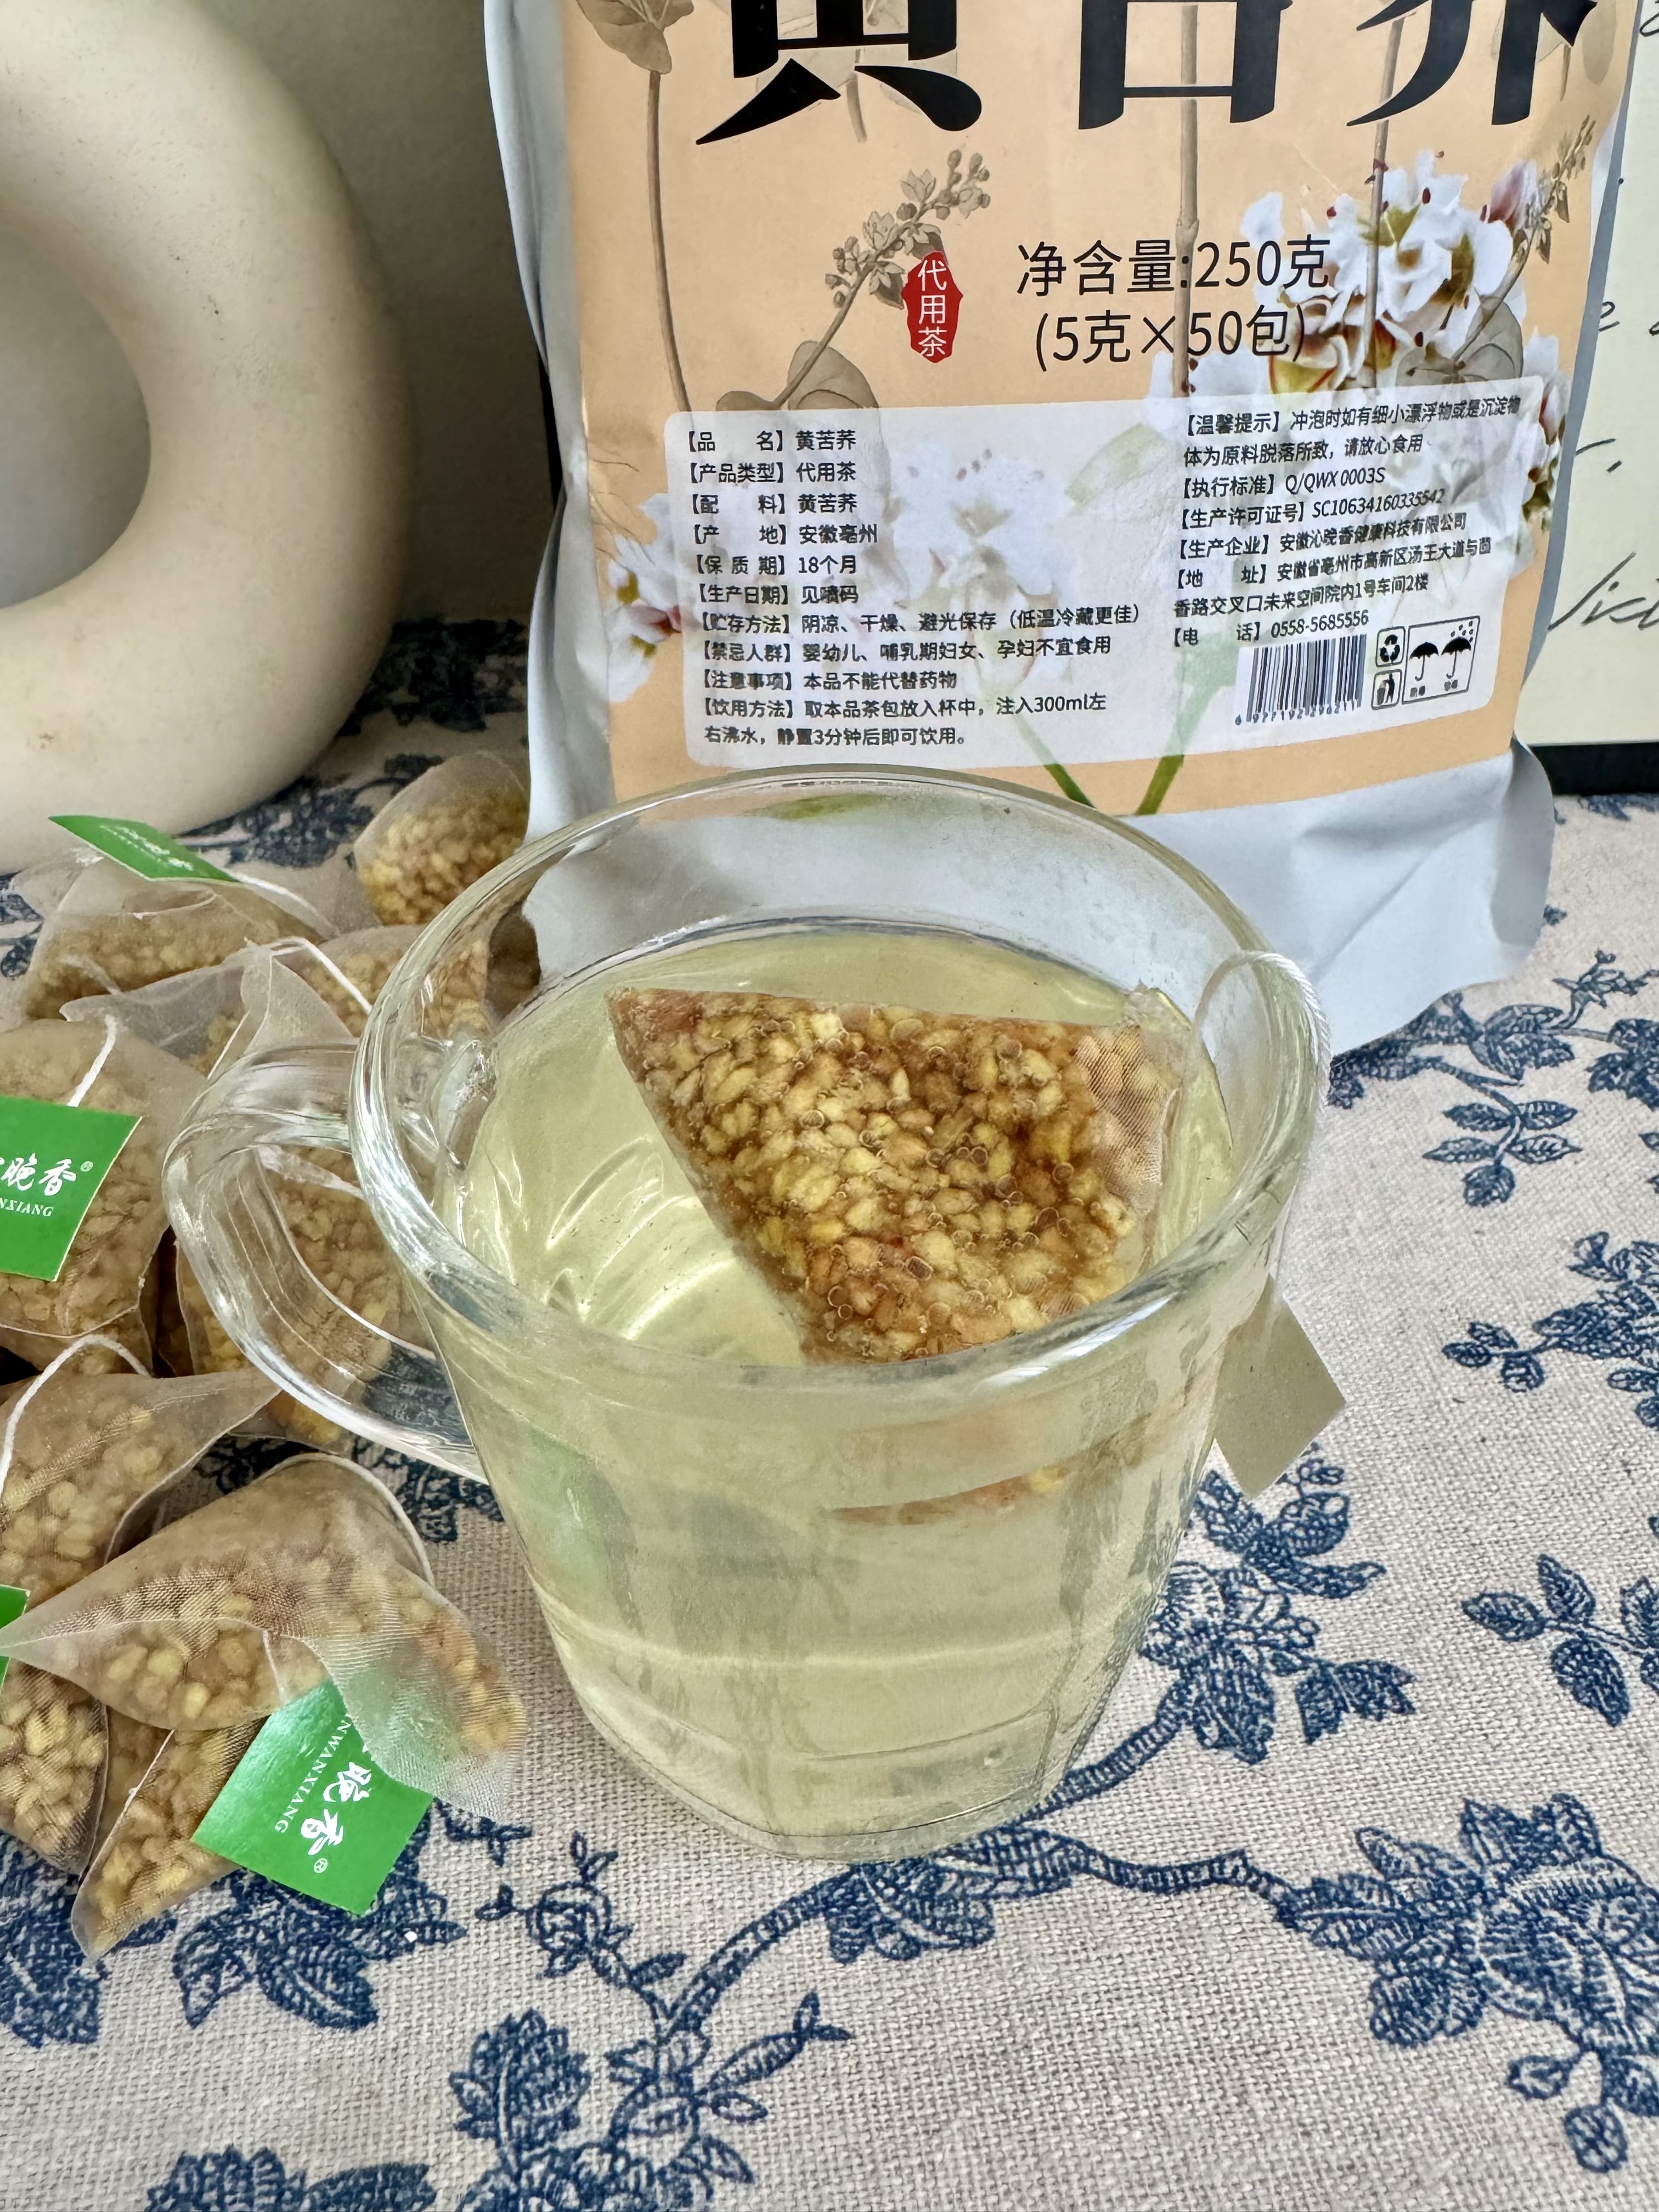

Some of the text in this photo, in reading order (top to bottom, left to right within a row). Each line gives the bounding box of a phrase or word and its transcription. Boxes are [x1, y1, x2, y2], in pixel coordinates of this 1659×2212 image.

[1017, 234, 1330, 297] 净含量:250克
[917, 259, 948, 358] 代用茶
[0, 1153, 77, 1196] 晚香
